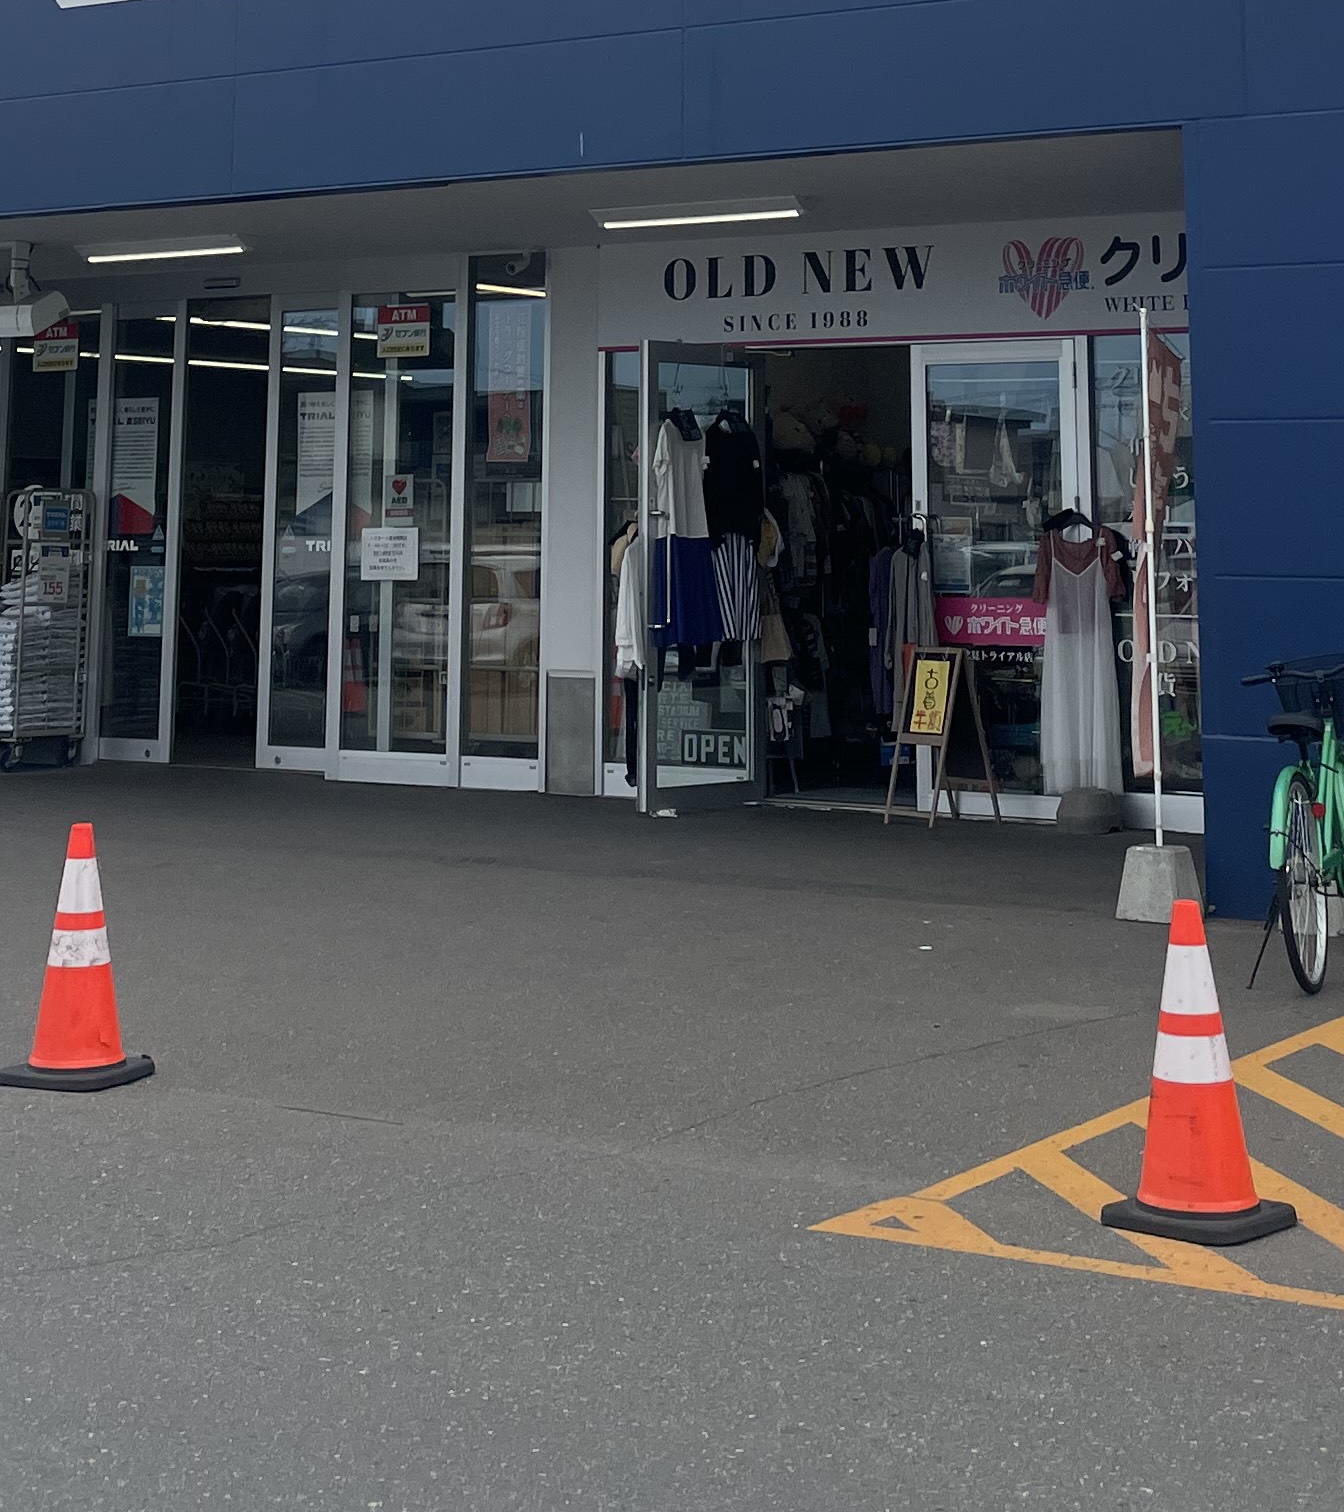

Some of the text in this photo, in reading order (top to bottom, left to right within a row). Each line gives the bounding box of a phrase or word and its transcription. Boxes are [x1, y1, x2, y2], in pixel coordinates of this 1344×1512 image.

[1101, 233, 1187, 286] クリ
[663, 244, 935, 301] OLD NEW
[1104, 294, 1175, 313] WHITE
[392, 309, 417, 321] ATM
[723, 309, 869, 333] SINCE 1988
[45, 326, 68, 338] ATM
[107, 539, 139, 552] RIAL
[305, 539, 331, 552] TRI
[42, 581, 63, 595] 155
[970, 603, 1024, 614] クリーニング
[967, 615, 1048, 636] ホワイト急便
[684, 734, 746, 764] OPEN
